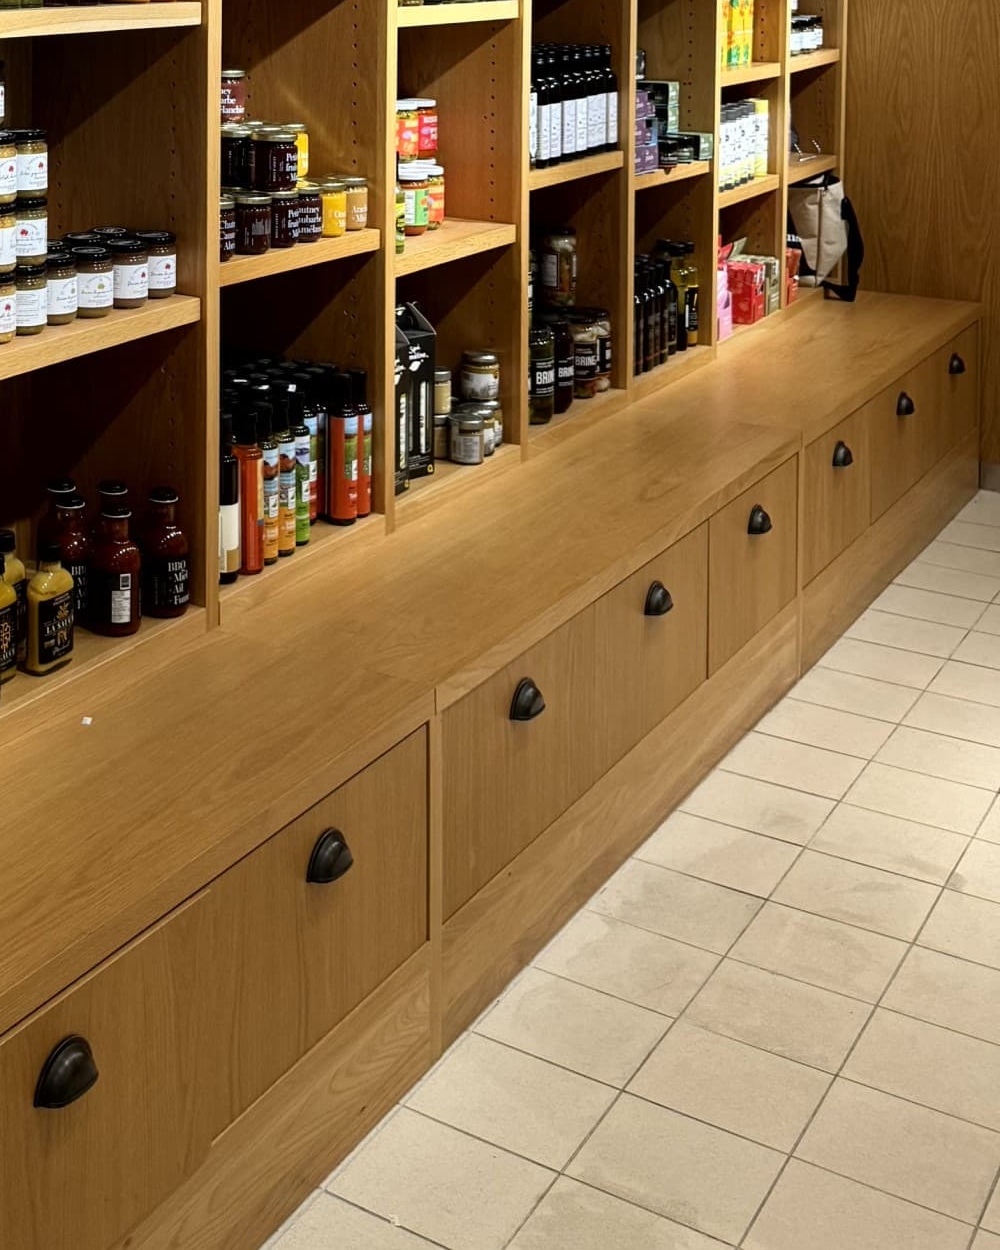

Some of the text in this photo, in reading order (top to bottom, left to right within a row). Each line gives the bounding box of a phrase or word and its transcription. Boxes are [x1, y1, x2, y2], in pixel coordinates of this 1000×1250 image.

[575, 355, 597, 366] BRINE
[536, 369, 555, 385] BRIN
[558, 365, 574, 378] BRIN
